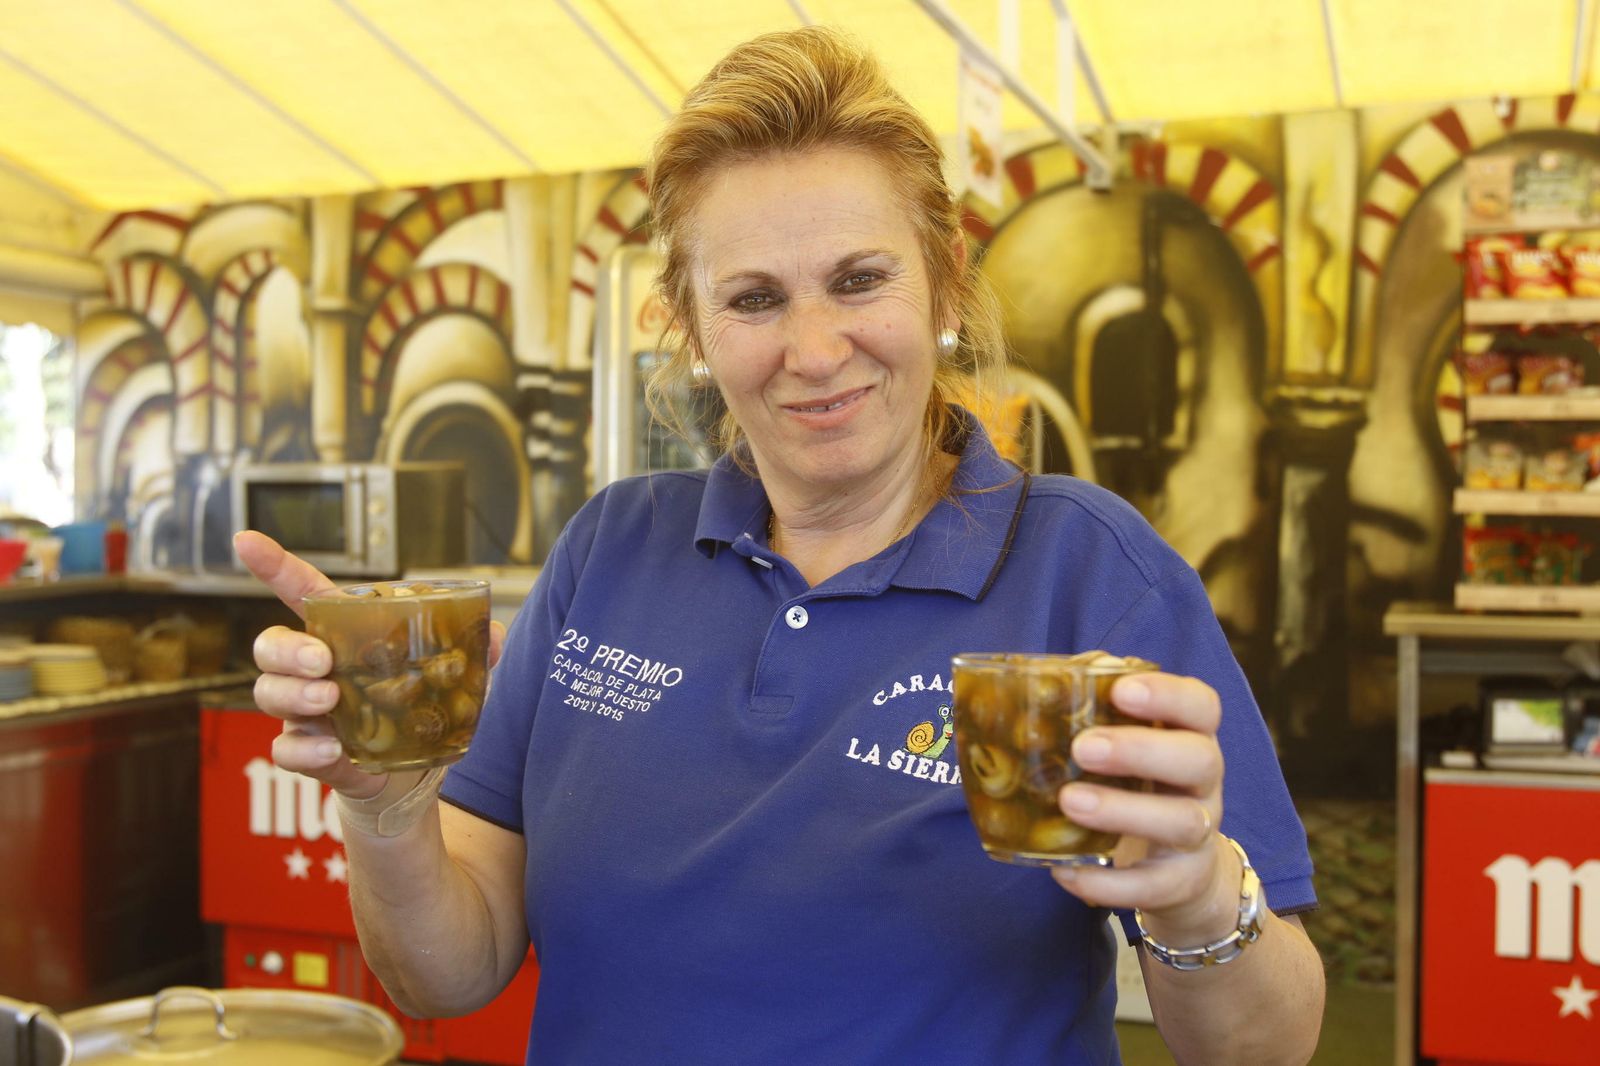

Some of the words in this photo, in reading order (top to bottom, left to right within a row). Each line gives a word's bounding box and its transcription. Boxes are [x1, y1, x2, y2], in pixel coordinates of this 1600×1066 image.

[554, 654, 603, 684] CARACOL
[605, 675, 625, 690] DE
[623, 683, 662, 702] PLATA
[591, 645, 683, 687] PREMIO
[550, 668, 567, 686] AL
[570, 678, 604, 698] MEJOR
[604, 689, 651, 712] PUESTO
[563, 694, 589, 711] 2012
[597, 703, 625, 722] 2015
[846, 737, 881, 766] LA
